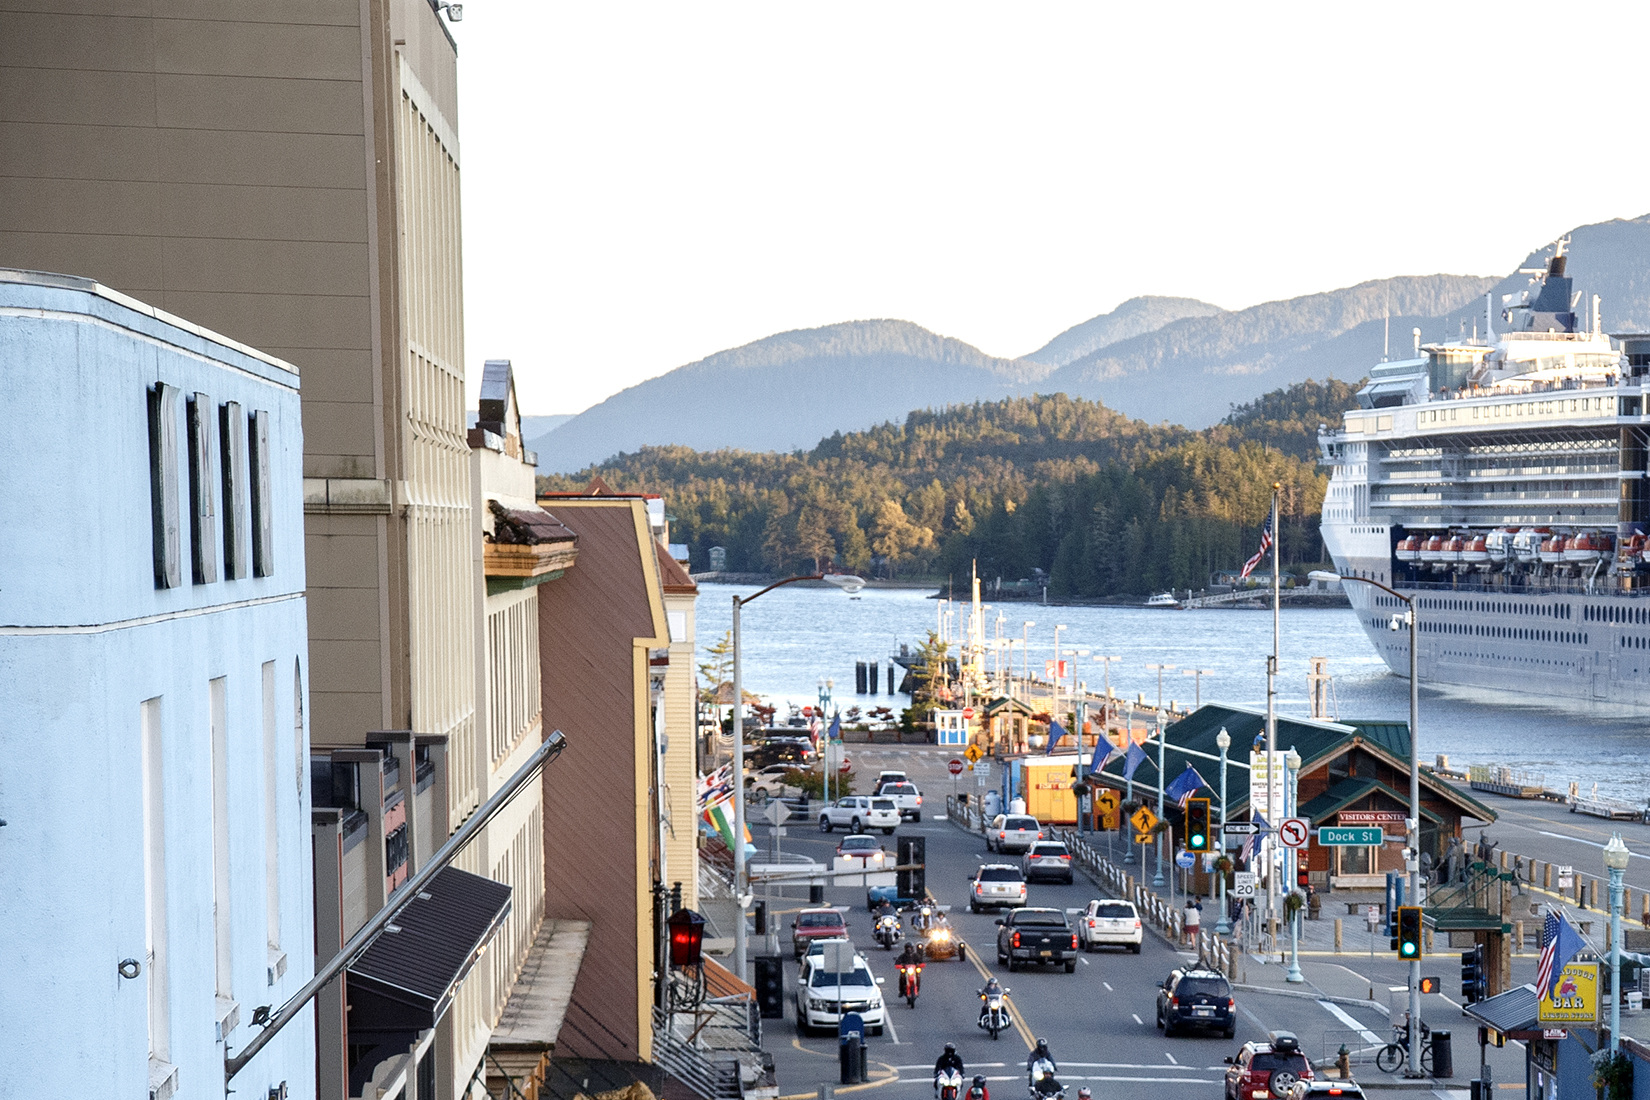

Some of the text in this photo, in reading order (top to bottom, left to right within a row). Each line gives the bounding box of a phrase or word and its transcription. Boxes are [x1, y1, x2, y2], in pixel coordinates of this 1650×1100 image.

[1327, 831, 1373, 841] Dock St
[1237, 884, 1253, 895] 20
[1553, 997, 1584, 1009] BAR
